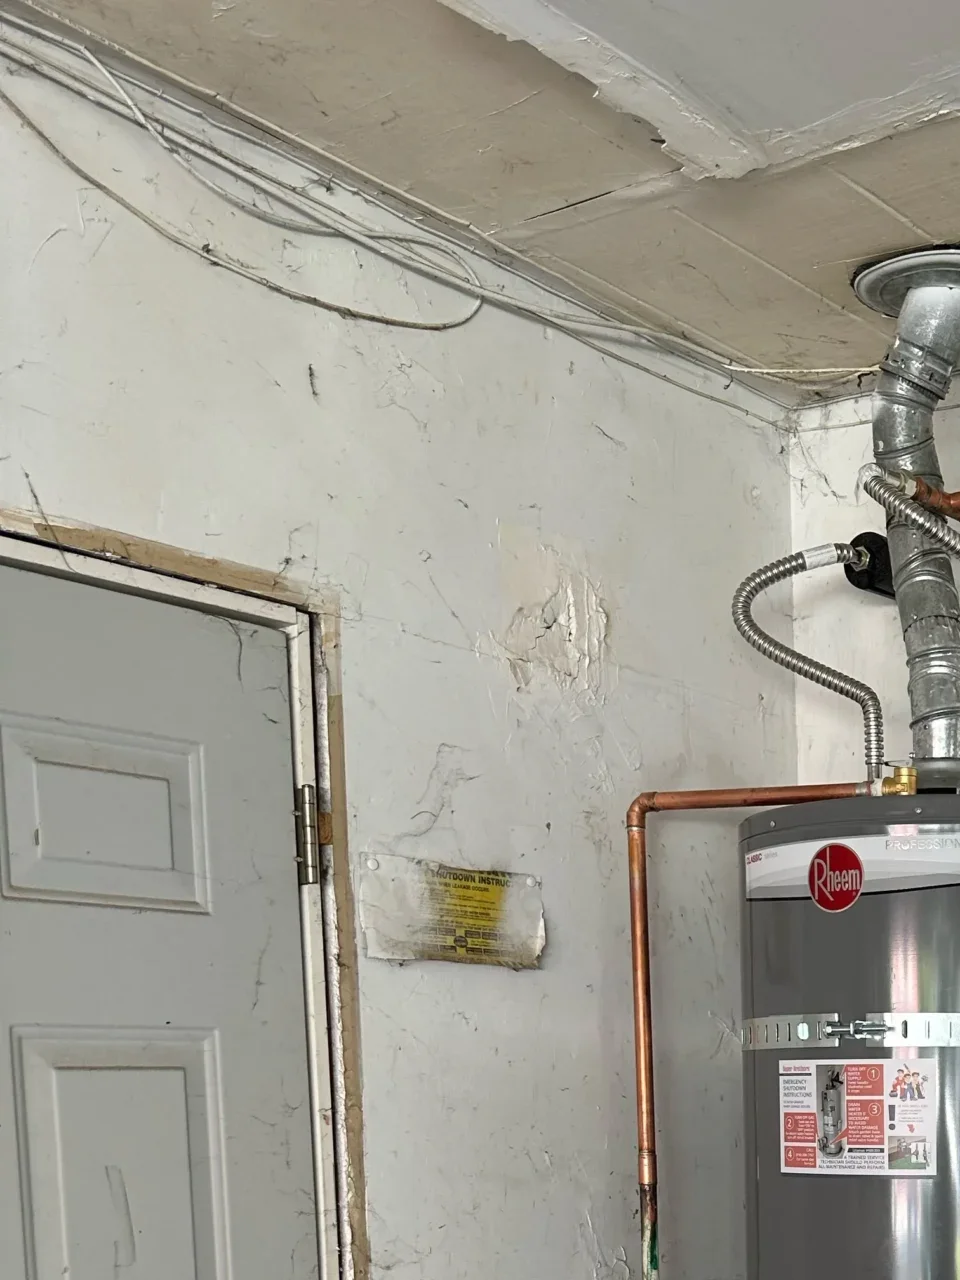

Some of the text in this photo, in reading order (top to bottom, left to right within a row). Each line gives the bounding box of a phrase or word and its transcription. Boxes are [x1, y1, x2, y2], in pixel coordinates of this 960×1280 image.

[814, 847, 861, 901] Rheem
[871, 1069, 876, 1078] 1
[872, 1105, 878, 1114] 3
[788, 1118, 792, 1128] 2
[788, 1150, 792, 1158] 4
